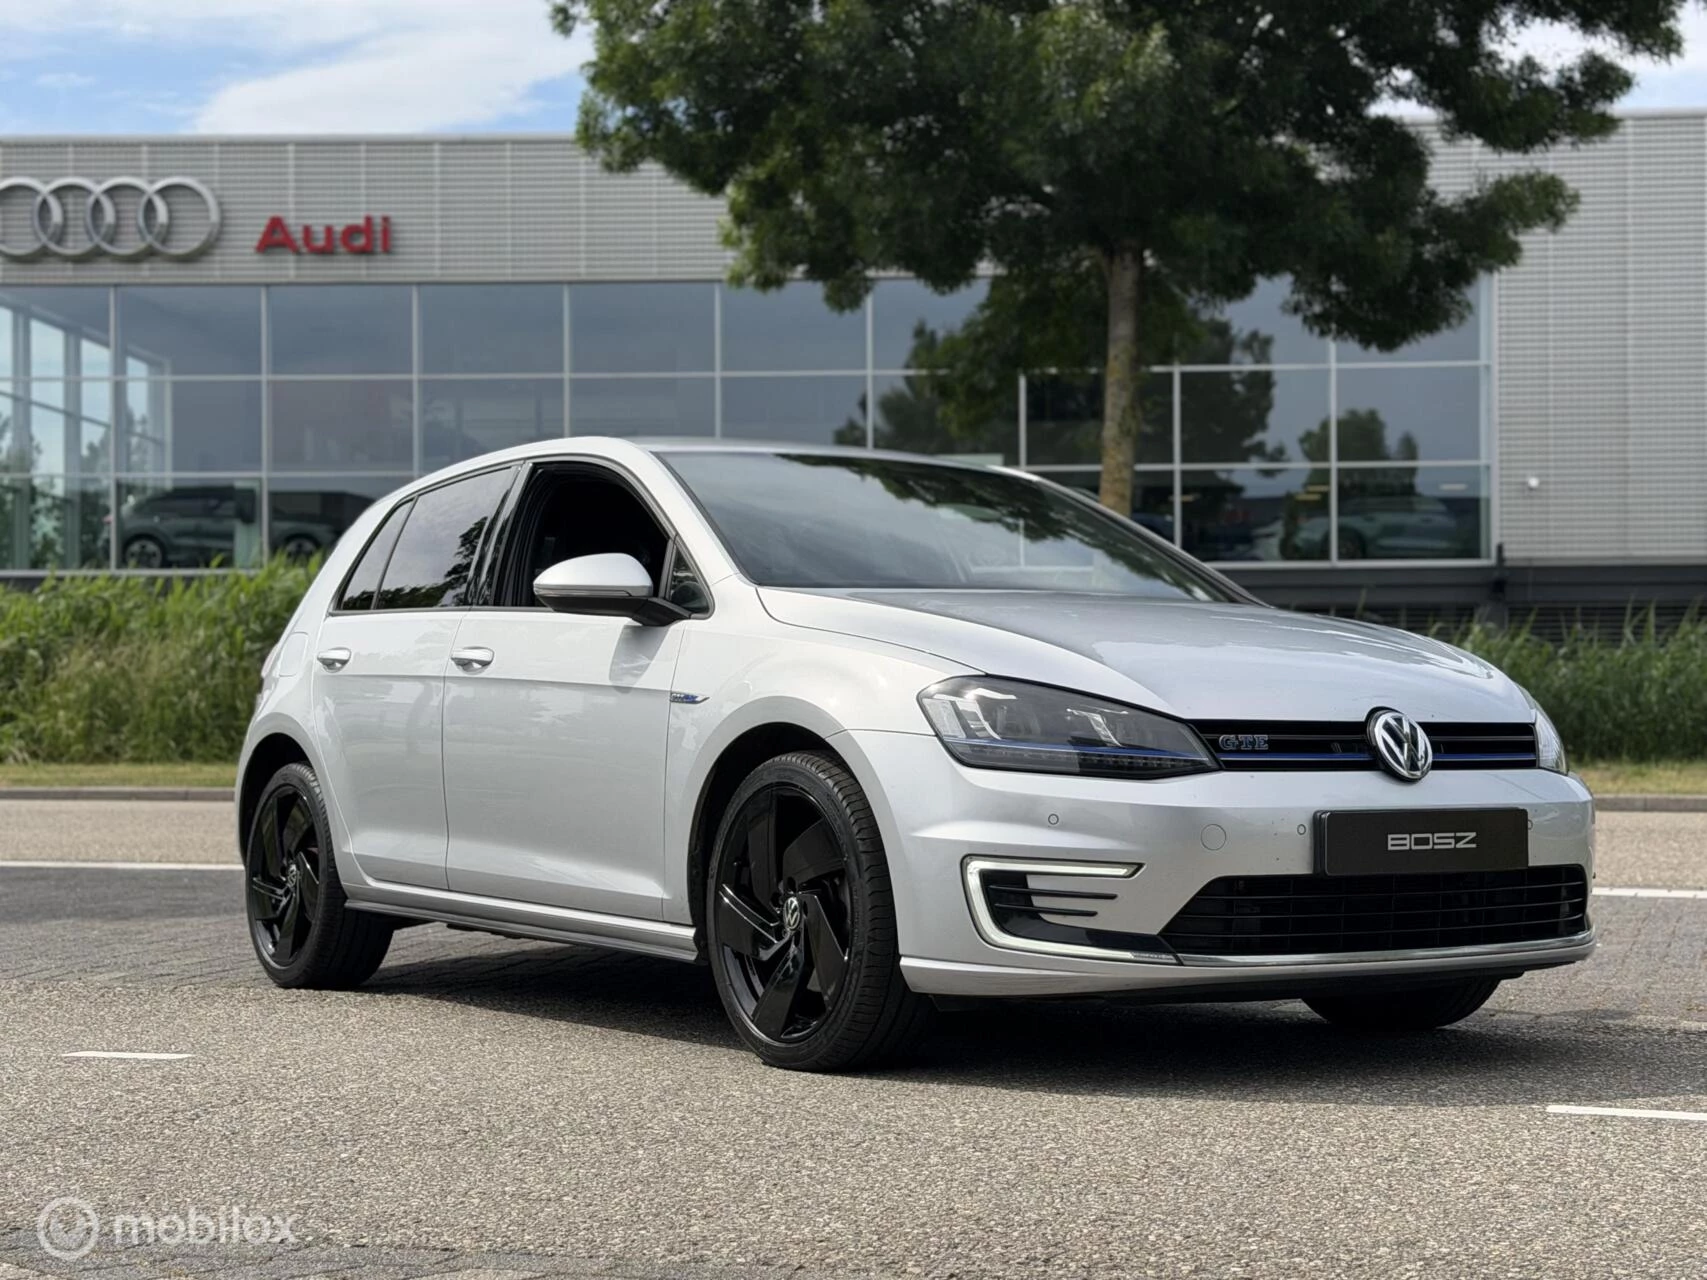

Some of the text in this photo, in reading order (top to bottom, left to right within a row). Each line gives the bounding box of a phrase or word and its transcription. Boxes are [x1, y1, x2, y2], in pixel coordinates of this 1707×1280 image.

[255, 215, 392, 254] Audi
[1218, 734, 1269, 751] GTE
[1387, 831, 1477, 851] BOSZ
